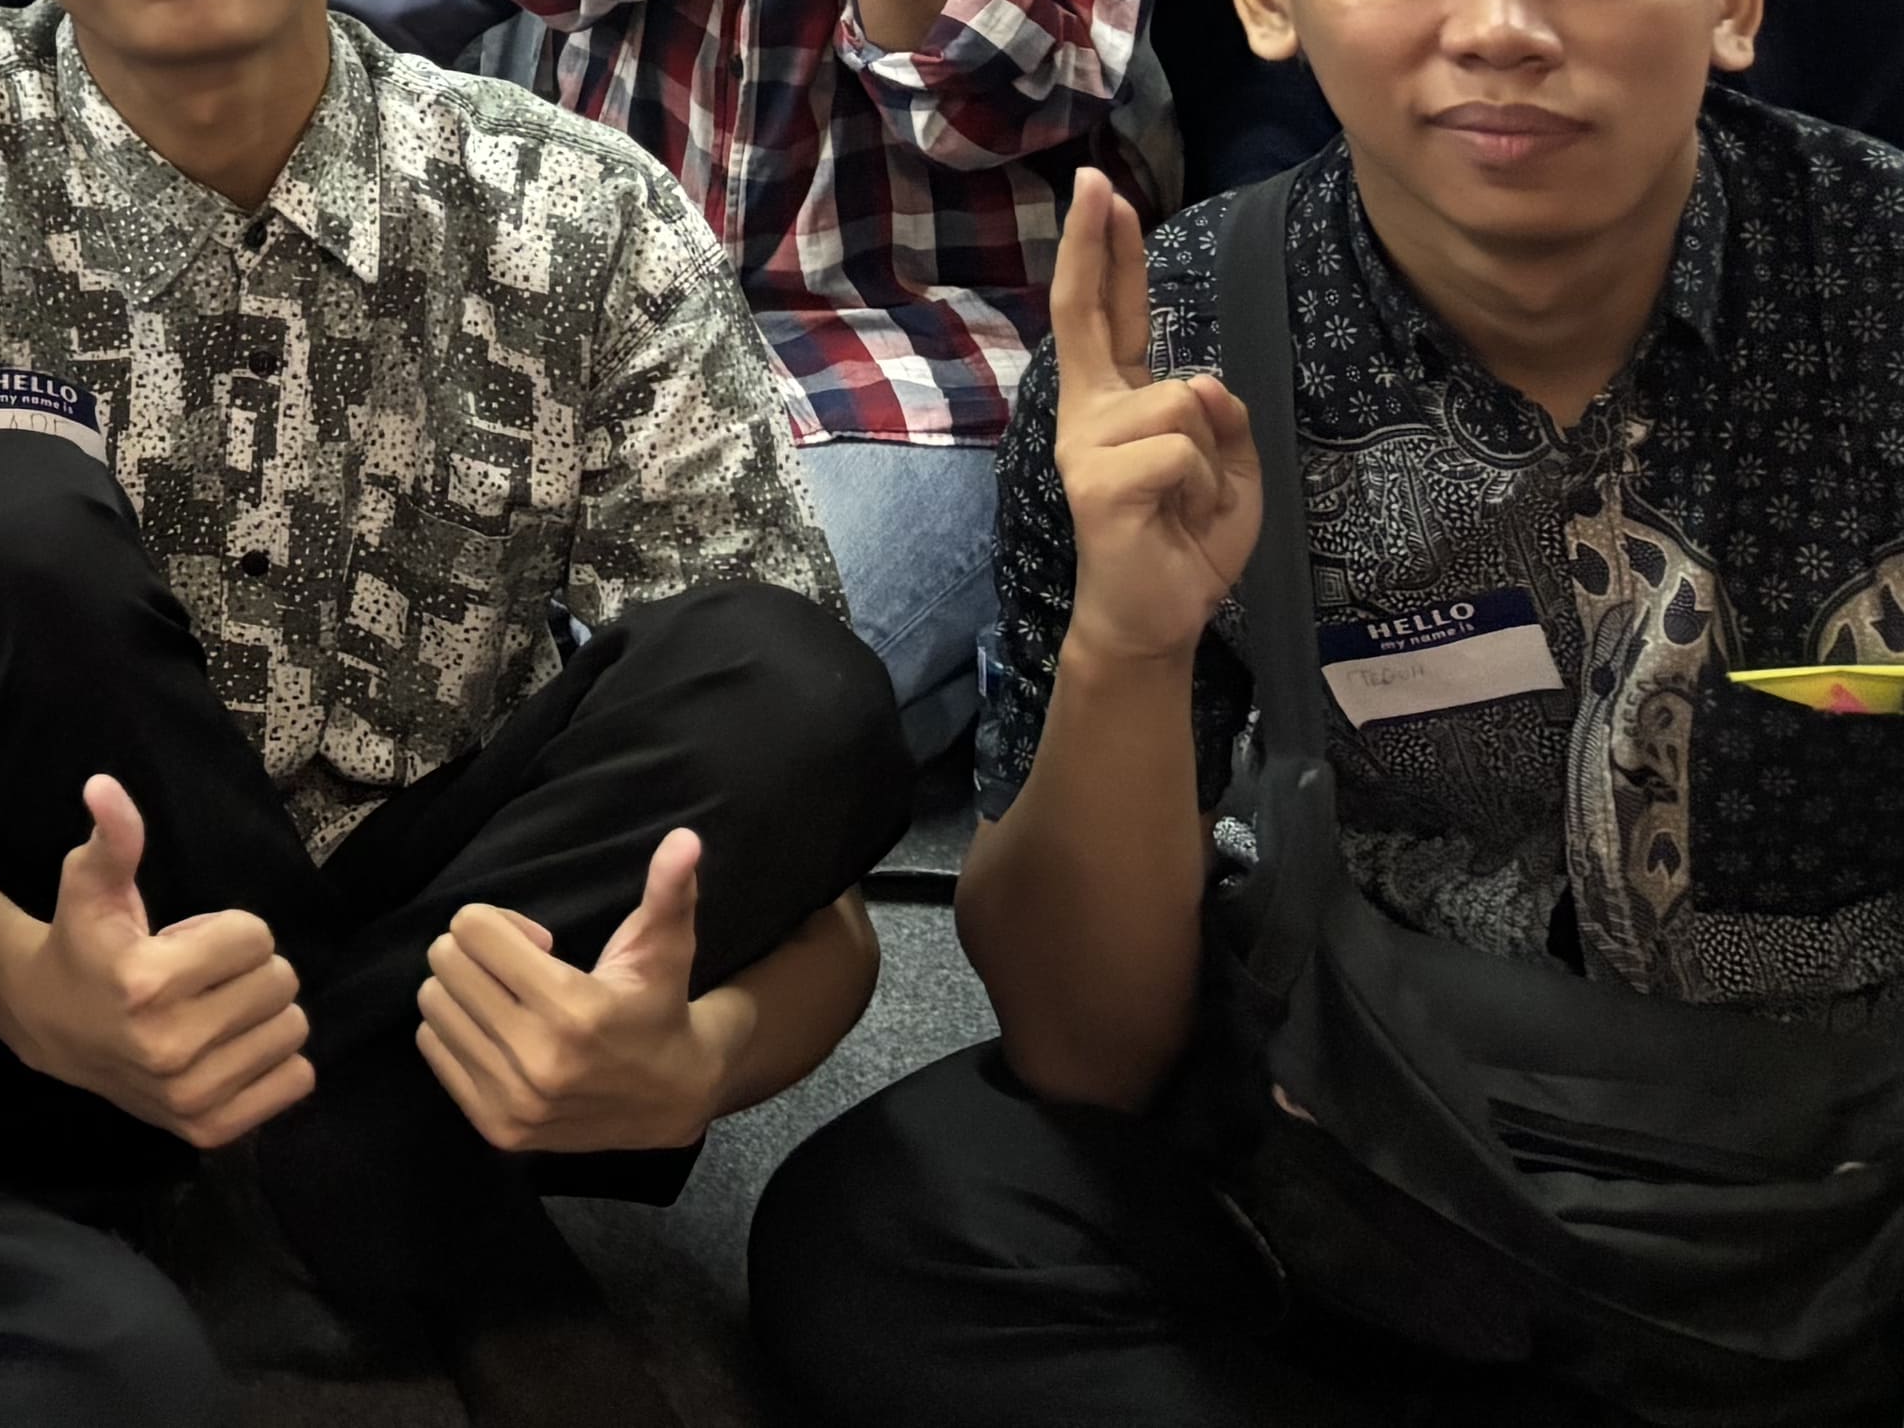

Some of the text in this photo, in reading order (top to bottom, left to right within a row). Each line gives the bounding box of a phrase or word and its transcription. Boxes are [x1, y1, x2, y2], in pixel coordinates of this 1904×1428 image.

[22, 395, 58, 411] name
[63, 402, 73, 415] is
[1366, 600, 1475, 641] HELLO
[1380, 623, 1474, 652] my name is
